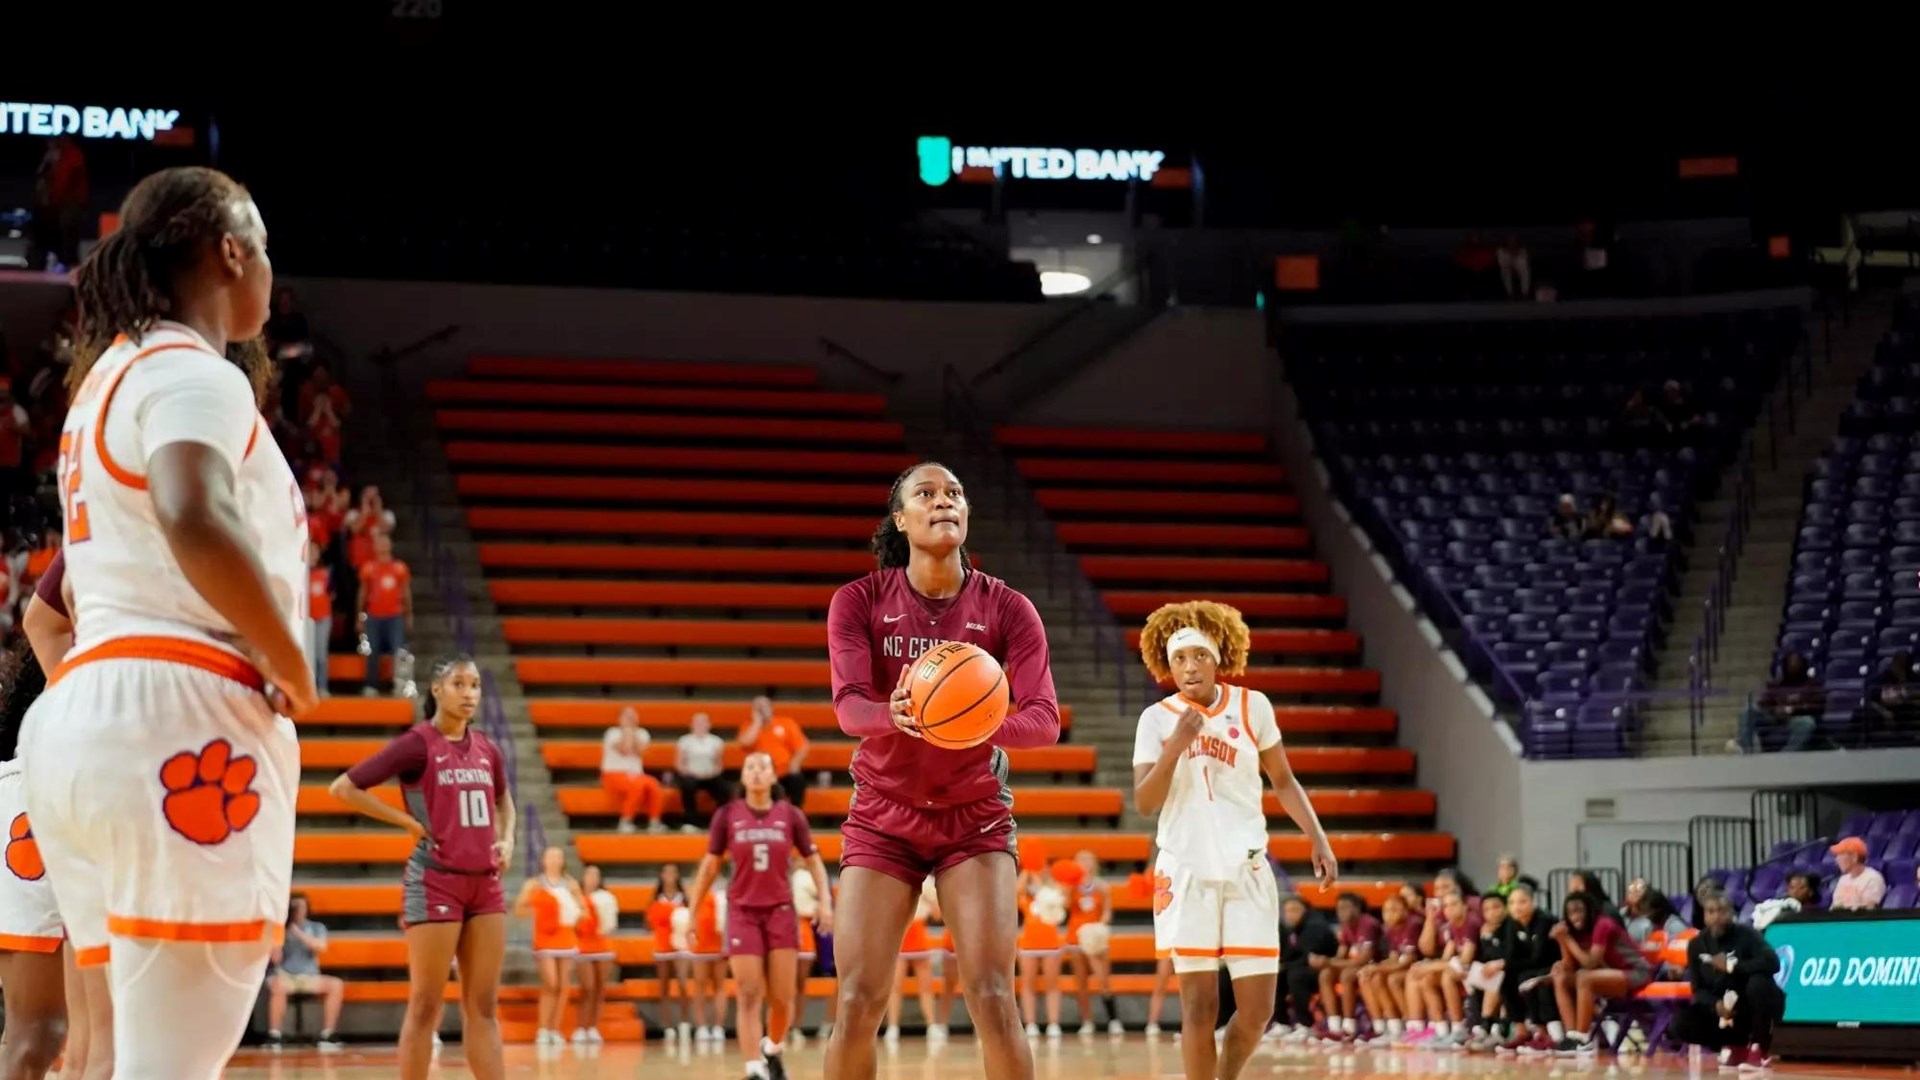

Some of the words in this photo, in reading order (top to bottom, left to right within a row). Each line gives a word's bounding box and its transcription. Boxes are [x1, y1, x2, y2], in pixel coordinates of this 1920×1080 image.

[82, 106, 180, 140] BANK
[883, 635, 903, 658] NC
[920, 643, 968, 681] ELITE
[1187, 734, 1238, 769] LEMSON
[459, 789, 491, 828] 10
[753, 843, 769, 872] 5
[1799, 957, 1842, 986] OLD
